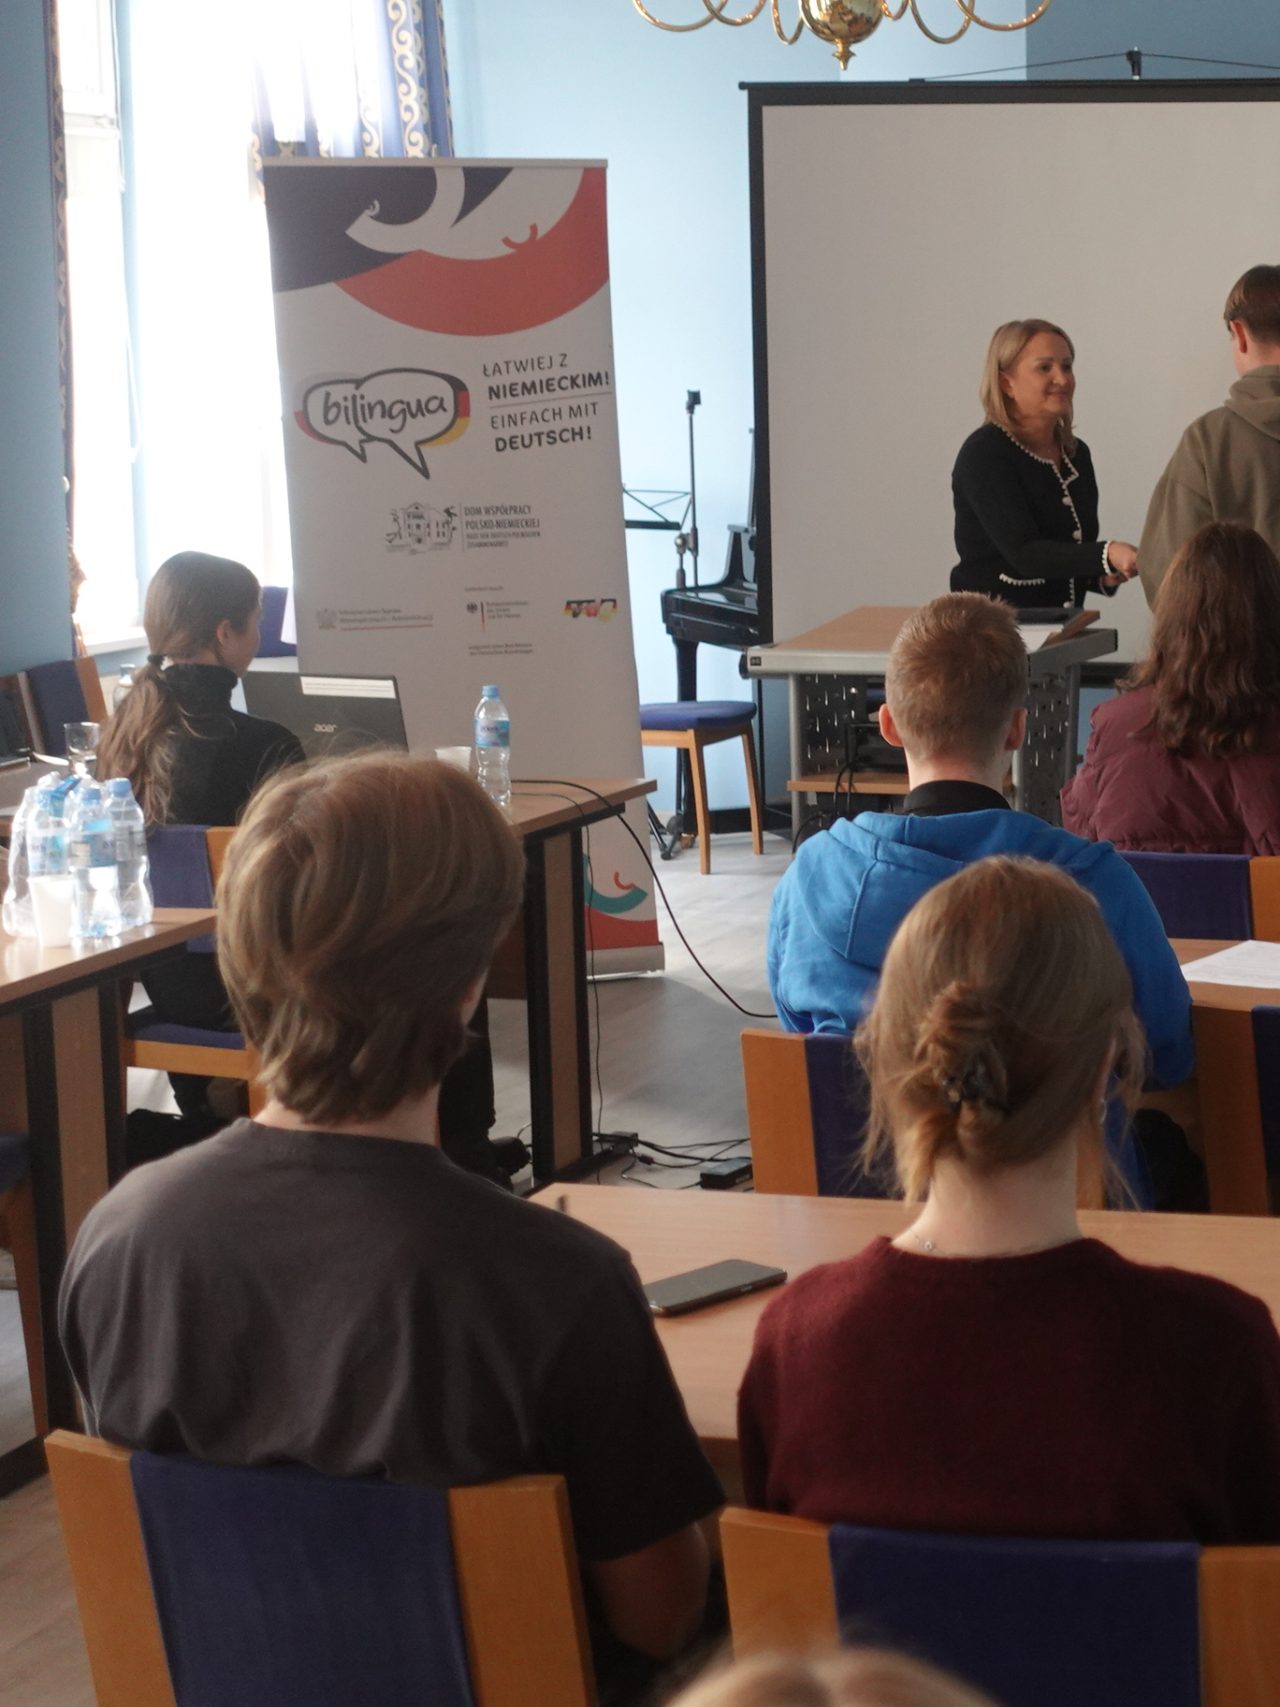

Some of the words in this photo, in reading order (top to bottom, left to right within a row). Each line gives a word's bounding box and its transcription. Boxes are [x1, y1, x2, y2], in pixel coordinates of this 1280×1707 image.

[482, 355, 553, 377] ŁATWIEJ
[559, 353, 568, 368] Z
[487, 370, 610, 401] NIEMIECKIM!
[323, 390, 448, 434] bilingua
[490, 407, 563, 430] EINFACH
[568, 401, 599, 420] MIT
[494, 425, 592, 452] DEUTSCH!
[313, 723, 337, 733] acer
